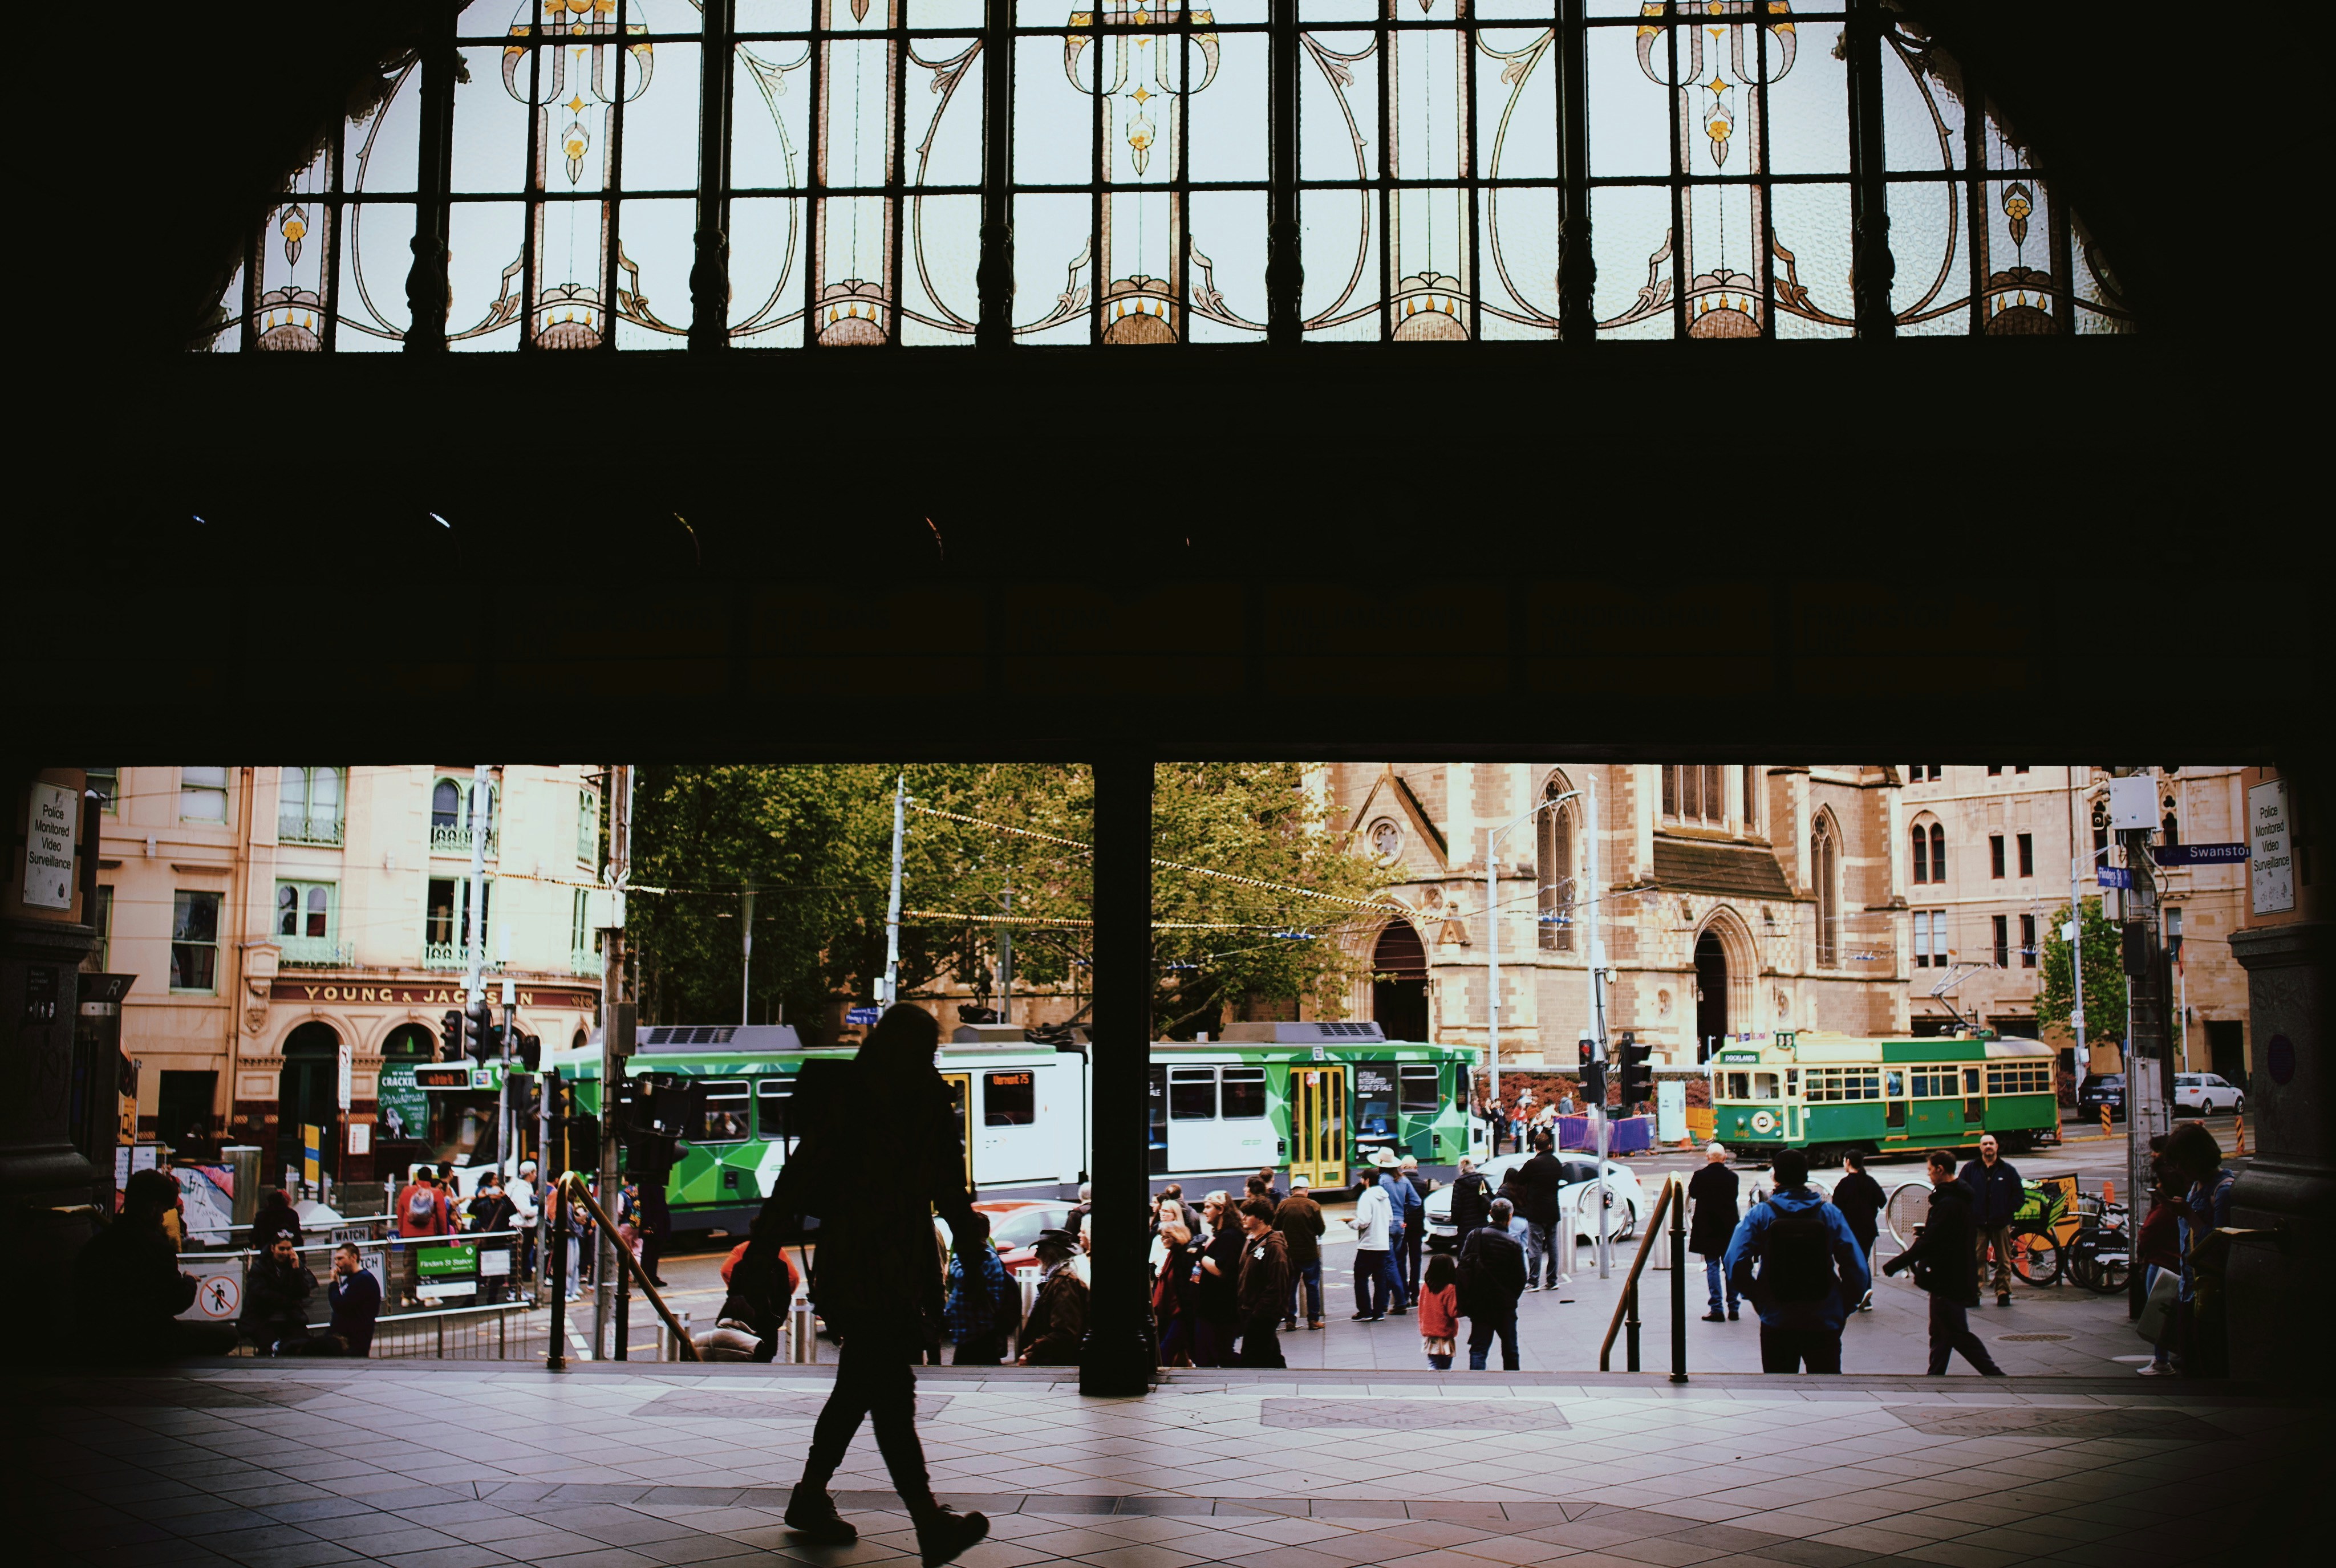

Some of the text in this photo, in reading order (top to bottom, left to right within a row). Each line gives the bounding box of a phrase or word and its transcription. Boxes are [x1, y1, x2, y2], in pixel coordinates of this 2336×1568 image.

[43, 804, 64, 820] Police
[2260, 806, 2278, 819] Police
[35, 819, 70, 837] Monitored
[2256, 819, 2284, 838] Monitored
[42, 836, 62, 852] Video
[2262, 839, 2279, 853] Video
[29, 851, 71, 870] Surveillance
[2254, 855, 2290, 872] Surveillance
[2099, 867, 2116, 880] Flinders
[303, 985, 534, 1006] YOUNG & JACSN
[1778, 1034, 1792, 1046] 35
[335, 1228, 366, 1241] WATCH
[360, 1257, 379, 1269] TCH
